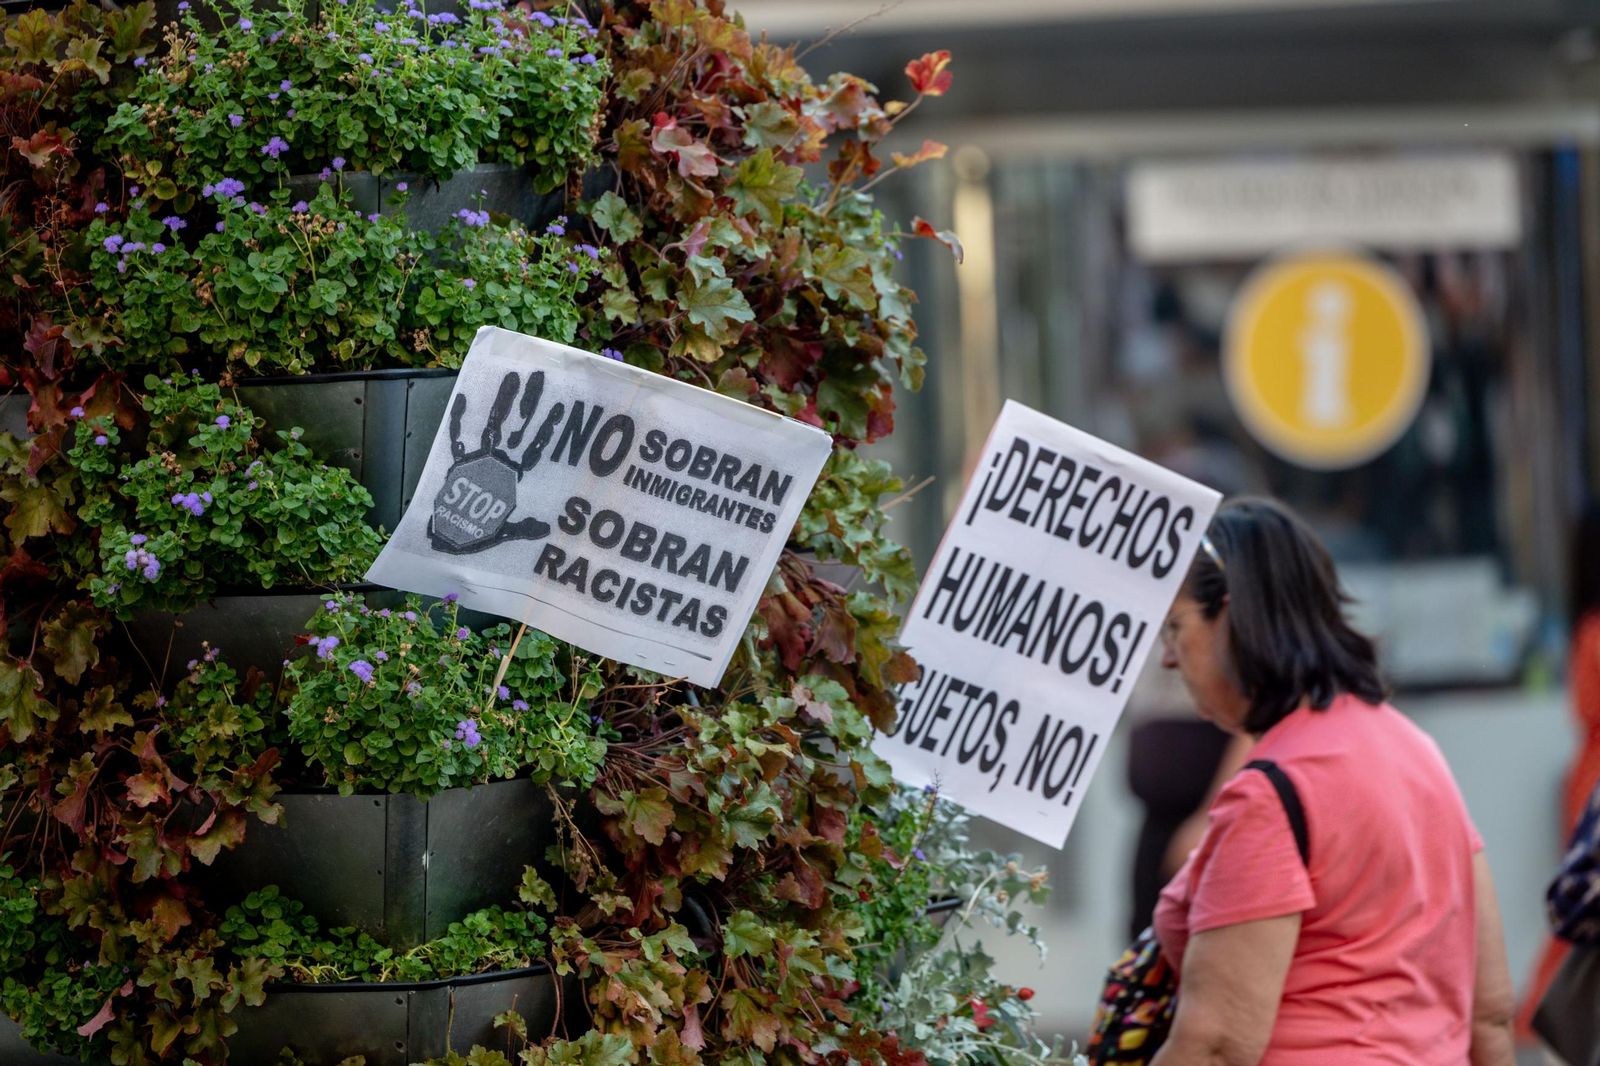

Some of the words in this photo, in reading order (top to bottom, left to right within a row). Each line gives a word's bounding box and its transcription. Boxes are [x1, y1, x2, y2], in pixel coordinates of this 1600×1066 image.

[550, 399, 635, 477] NO
[638, 429, 793, 506] SOBRAN
[623, 465, 777, 534] INMIGRANTES
[435, 505, 484, 538] RACISMO
[443, 477, 507, 524] STOP
[557, 496, 749, 593] SOBRAN
[965, 437, 1194, 579] ¡DERECHOS
[533, 543, 728, 638] RACISTAS
[923, 546, 1148, 694] HUMANOS!
[1014, 713, 1098, 807] NO!
